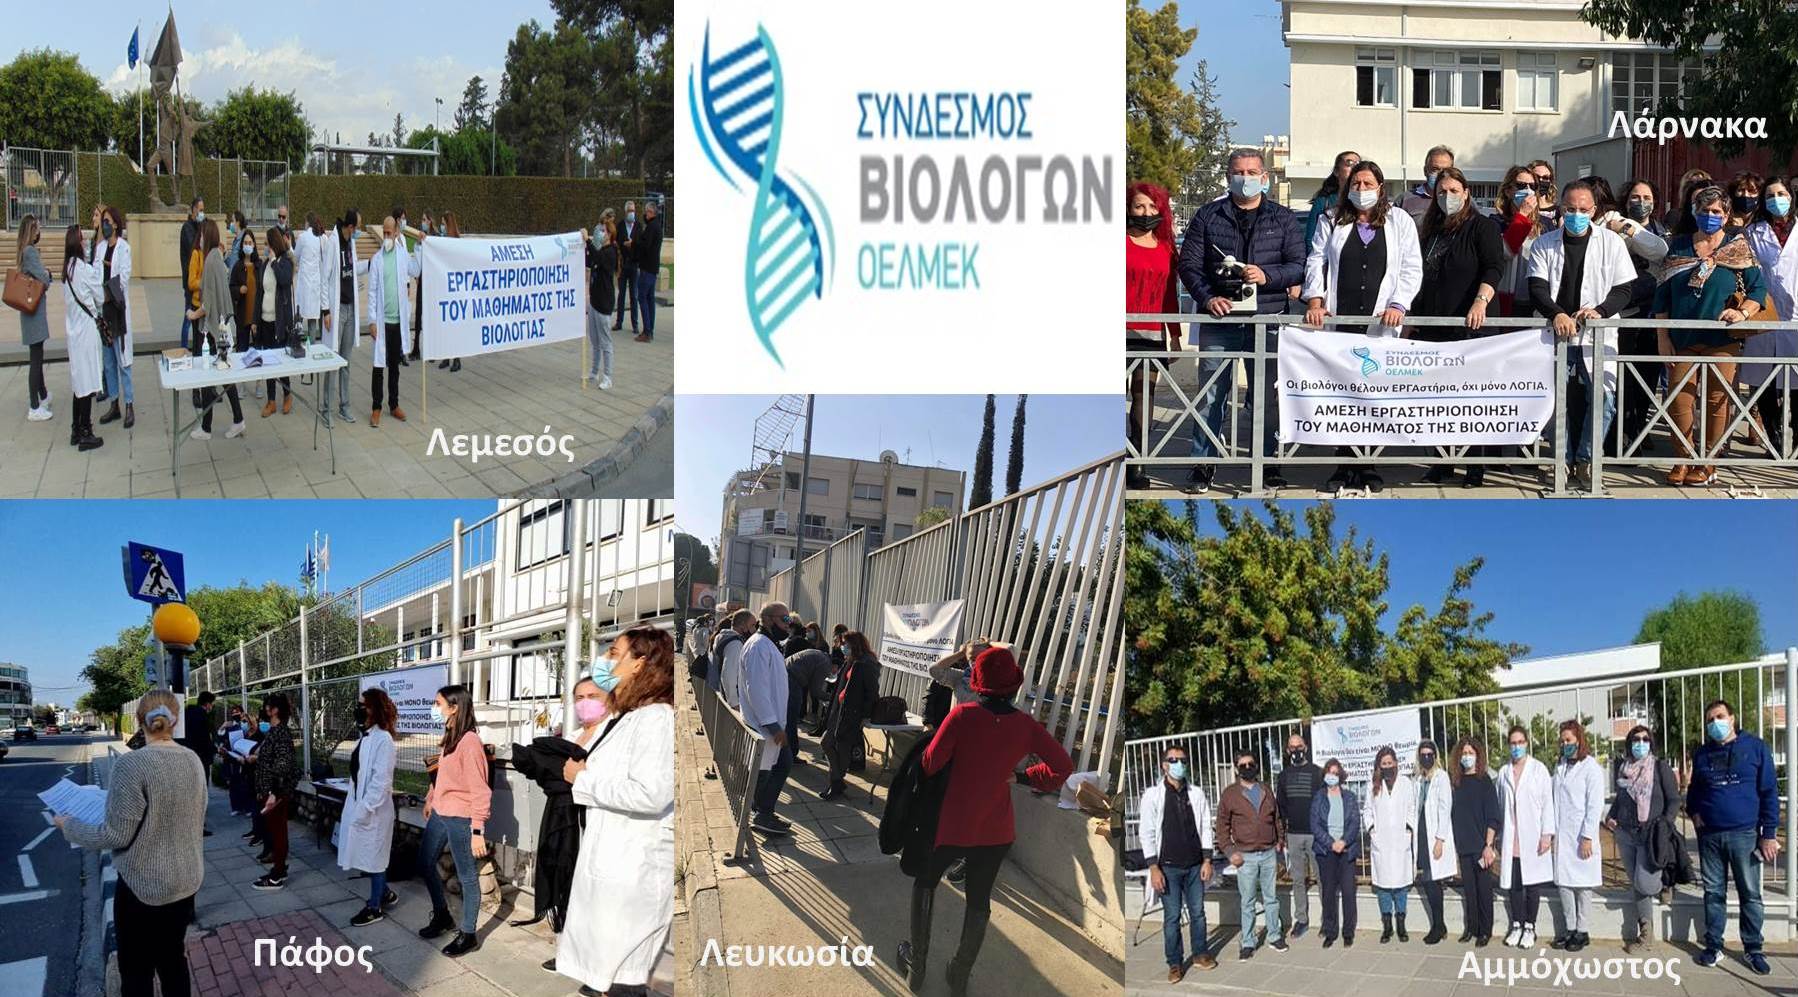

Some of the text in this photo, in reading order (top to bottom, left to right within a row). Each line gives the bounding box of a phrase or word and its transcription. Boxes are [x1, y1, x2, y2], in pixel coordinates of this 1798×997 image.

[491, 244, 535, 262] ΑΜΕΣΗ
[447, 265, 569, 292] ΕΡΓΑΣΤΗΡΙΟΠΟΙΗΣΗ
[439, 288, 576, 322] ΤΟΥ ΜΑΘΗΜΑΤΟΣ ΤΗΣ
[481, 318, 545, 346] ΒΙΟΛΟΓΙΑΣ
[1386, 355, 1465, 367] ΒΙΟΛΟΓΩΝ
[1385, 368, 1423, 376] ΟΕΛΜΕΚ
[1286, 380, 1299, 390] Οι
[1300, 379, 1348, 393] βιολόγοι
[1350, 380, 1390, 393] θέλουν
[1462, 380, 1478, 393] όχι
[1481, 380, 1507, 393] μόνο
[1509, 381, 1548, 391] ΛΟΓΙΑ.
[1314, 404, 1519, 419] ΑΜΕΣΗ ΕΡΓΑΣΤΗΡΙΟΠΟΙΗΣΗ
[1294, 420, 1540, 434] ΤΟΥ ΜΑΘΗΜΑΤΟΣ ΤΗΣ ΒΙΟΛΟΓΙΑΣ
